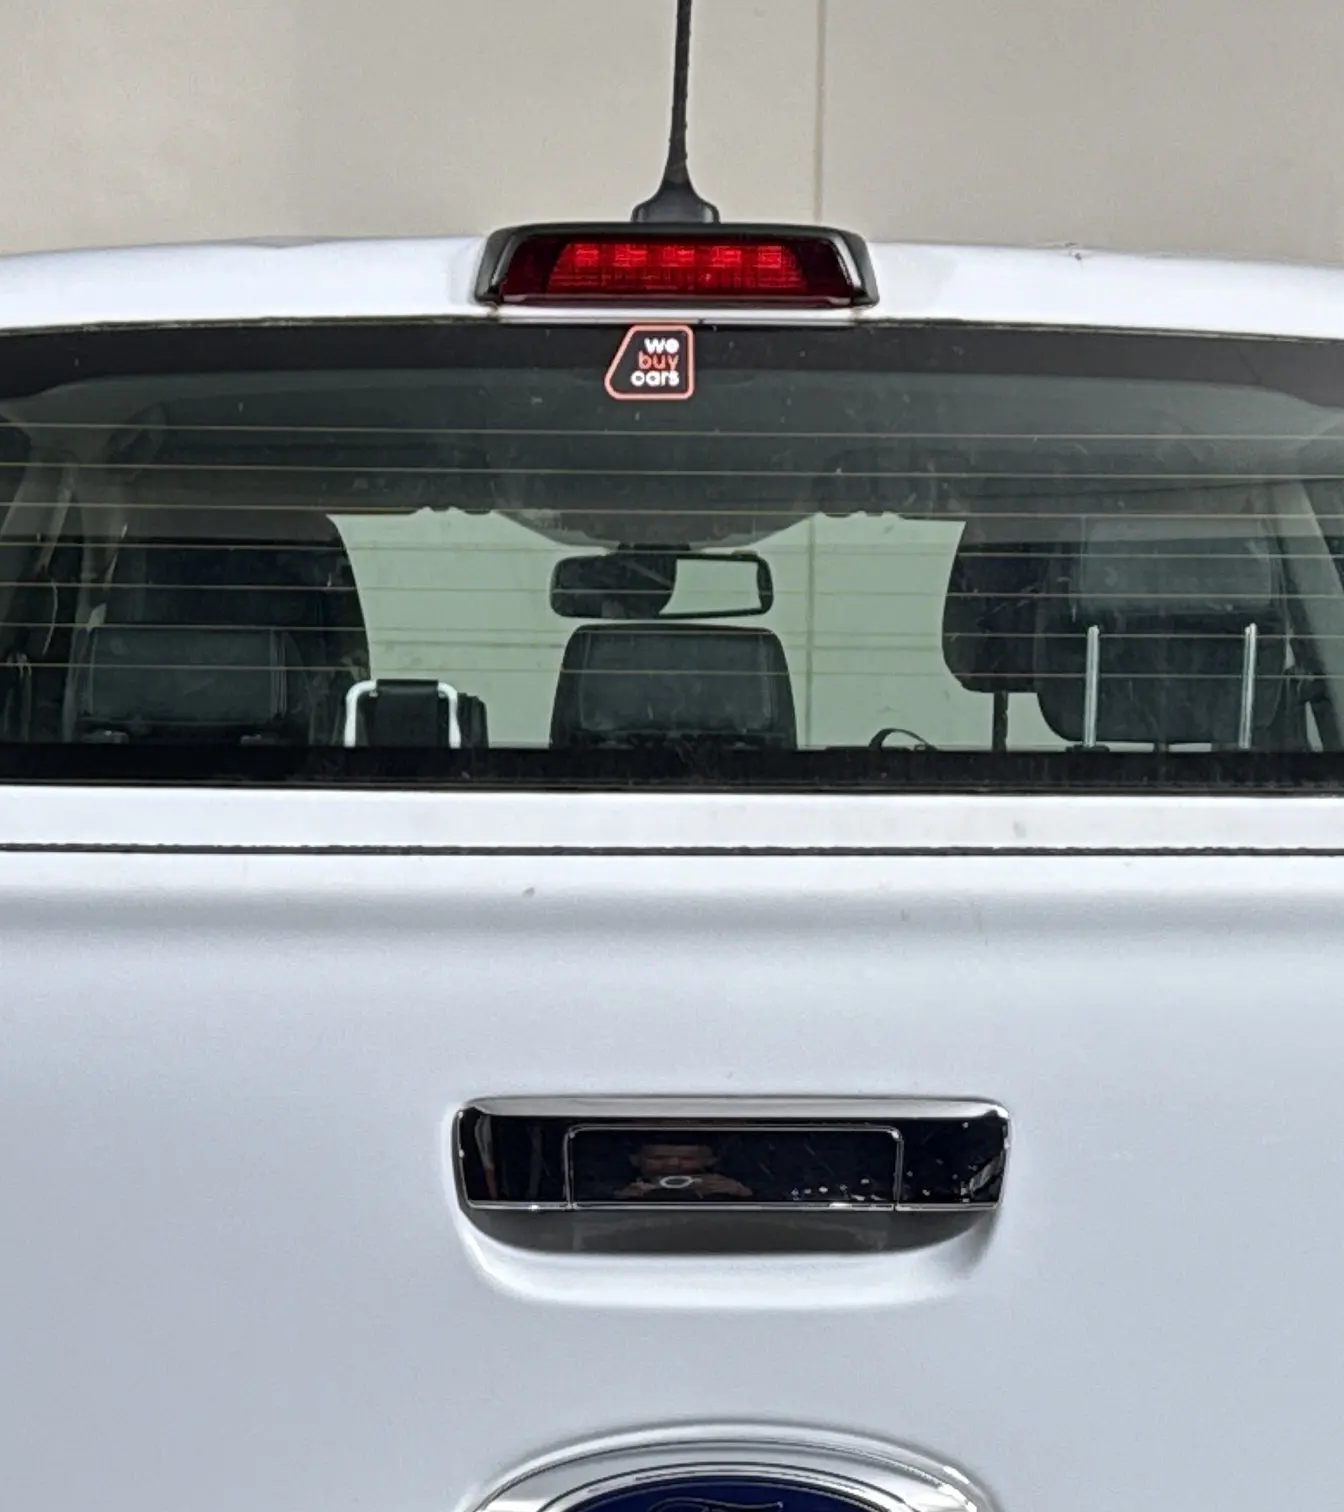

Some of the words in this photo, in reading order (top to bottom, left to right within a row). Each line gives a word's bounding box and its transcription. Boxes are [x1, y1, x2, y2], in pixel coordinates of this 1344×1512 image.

[643, 337, 680, 354] we
[638, 350, 679, 371] buy
[630, 370, 680, 387] cars
